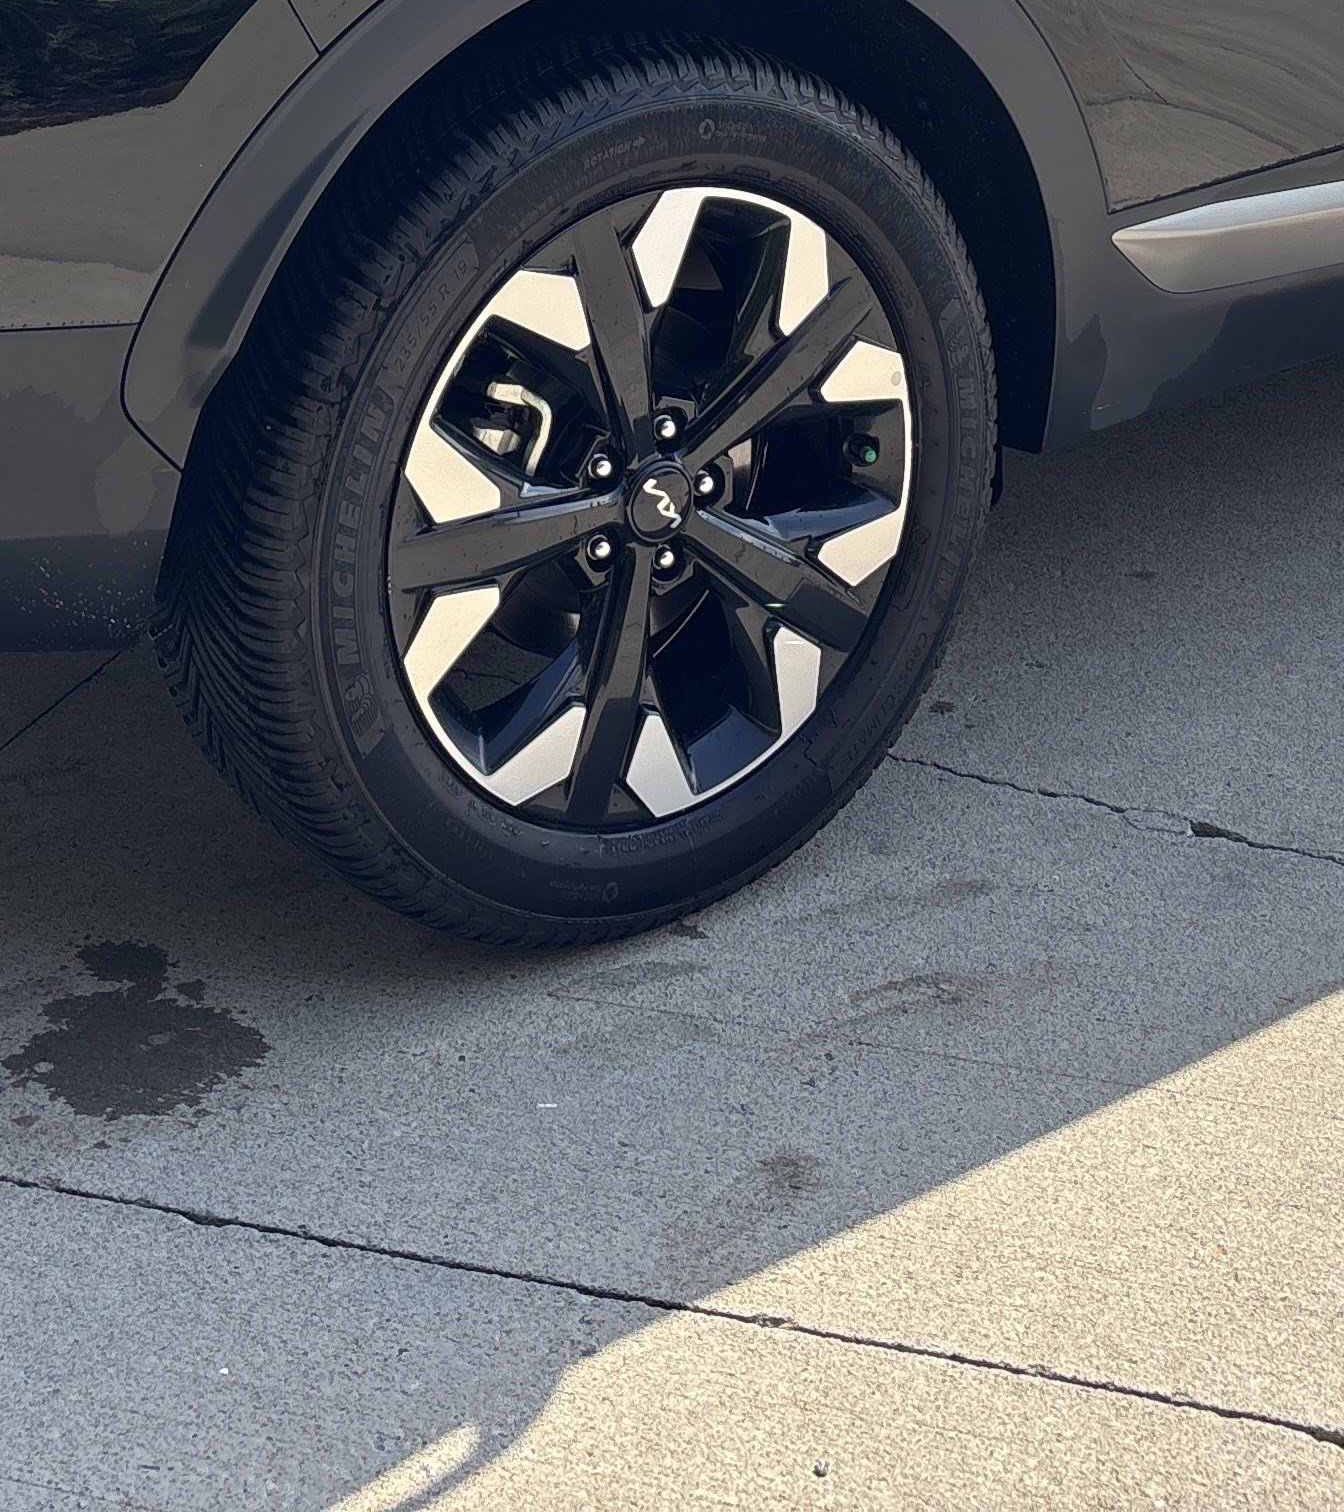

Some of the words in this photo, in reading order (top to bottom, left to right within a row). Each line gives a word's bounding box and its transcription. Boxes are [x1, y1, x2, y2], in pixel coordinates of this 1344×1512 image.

[394, 302, 438, 372] 235/55
[438, 283, 450, 302] R
[453, 260, 467, 281] 19
[332, 402, 386, 665] MICHELIN
